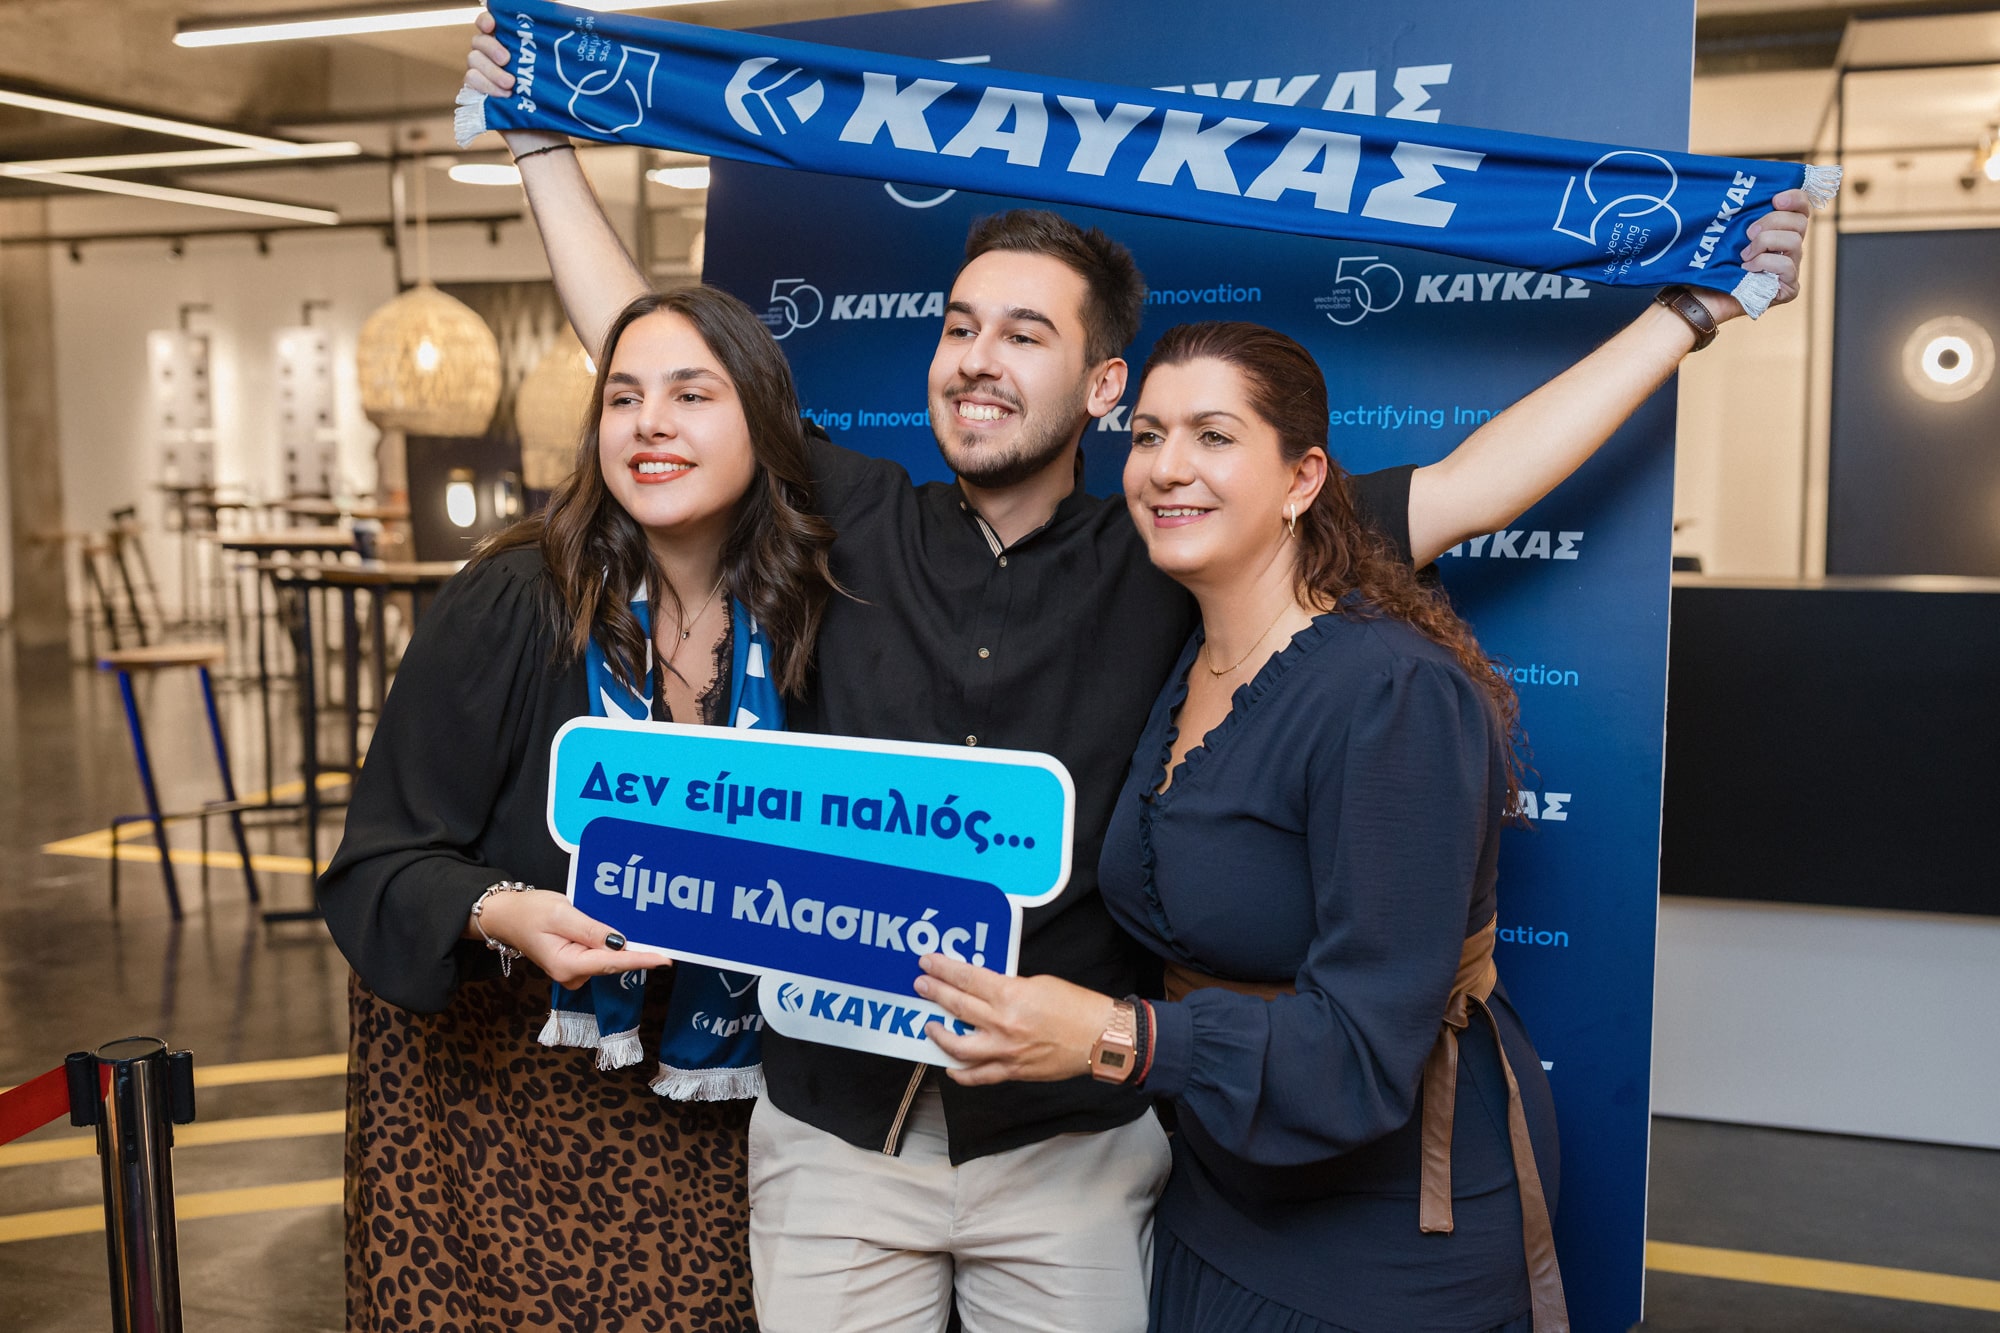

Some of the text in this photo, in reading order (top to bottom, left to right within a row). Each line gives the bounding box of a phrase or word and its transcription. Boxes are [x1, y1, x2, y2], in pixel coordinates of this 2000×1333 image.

[839, 72, 1487, 228] ΚΑΥΚΑΣ
[1688, 170, 1757, 270] ΚΑΥΚΑΣ
[1605, 222, 1624, 255] years
[1414, 271, 1591, 303] ΚΑΥΚΑΣ
[830, 291, 945, 321] ΚΑΥΚΑ
[858, 408, 931, 427] Innovat
[1329, 405, 1445, 430] ectrifying
[579, 761, 1036, 855] Δεν είμαι παλιός...
[594, 854, 989, 968] είμαι κλασικός!
[1495, 926, 1569, 948] ation
